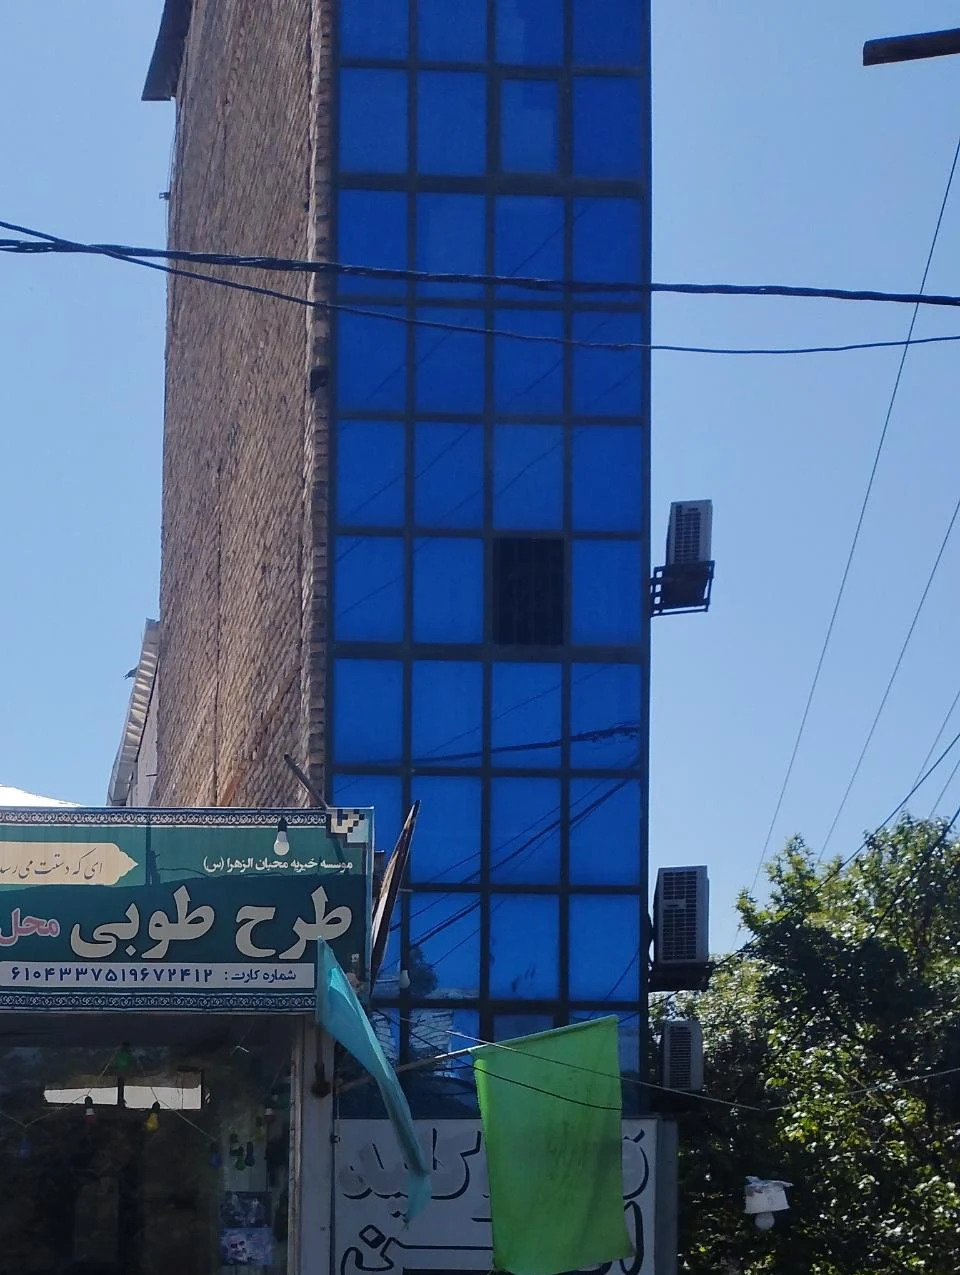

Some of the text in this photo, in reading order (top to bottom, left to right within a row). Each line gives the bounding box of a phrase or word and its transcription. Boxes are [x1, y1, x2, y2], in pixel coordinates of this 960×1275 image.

[71, 847, 97, 876] که
[226, 857, 254, 873] الزهرا
[254, 857, 289, 871] محبان
[289, 857, 318, 873] خیریه
[320, 859, 354, 874] موسسه
[83, 860, 104, 880] ای
[70, 885, 353, 961] طرح طوبی
[262, 968, 297, 982] شماره
